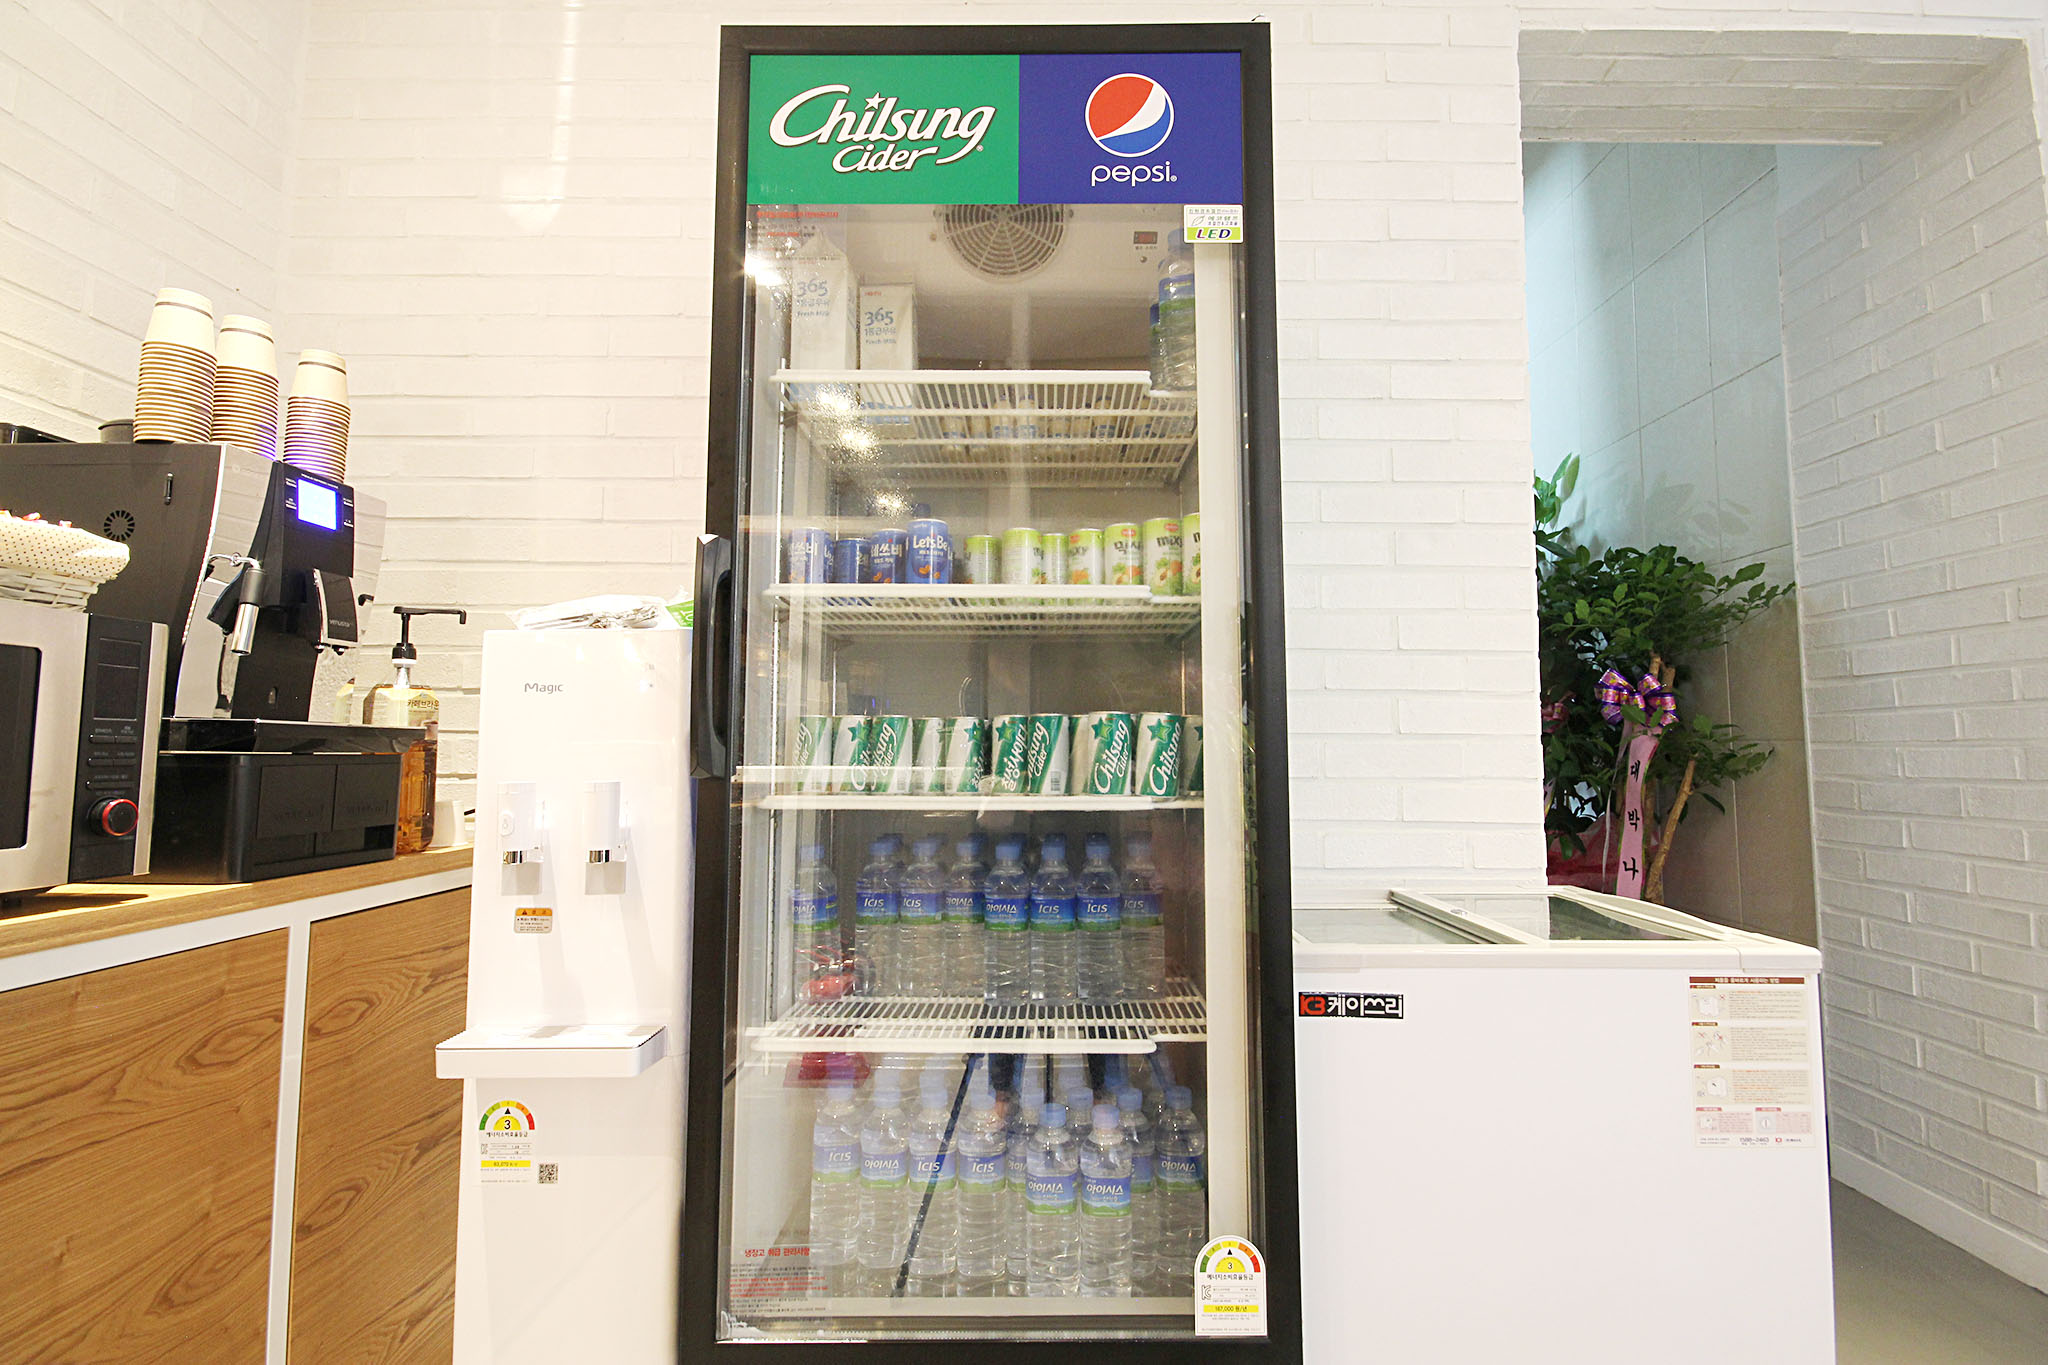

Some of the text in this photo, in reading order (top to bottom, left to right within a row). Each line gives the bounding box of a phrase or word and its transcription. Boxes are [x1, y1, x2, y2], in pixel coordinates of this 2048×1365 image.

[769, 83, 996, 165] Chilsung
[832, 142, 939, 174] Cider
[1091, 160, 1172, 187] pepsi
[1196, 228, 1232, 239] LED
[796, 278, 829, 298] 365
[864, 307, 894, 327] 365
[524, 682, 564, 695] Magic
[1033, 743, 1048, 777] Cider
[1094, 719, 1131, 794] Chilsung
[1116, 742, 1130, 778] Cider
[986, 903, 1018, 915] 아이시스
[504, 1119, 511, 1130] 3
[972, 1161, 995, 1174] ICIS
[1161, 1159, 1197, 1173] 아이시스
[1028, 1181, 1064, 1194] 아이시스
[1086, 1182, 1124, 1196] 아이시스
[744, 1248, 765, 1258] 냉장고
[1227, 1262, 1233, 1270] 3
